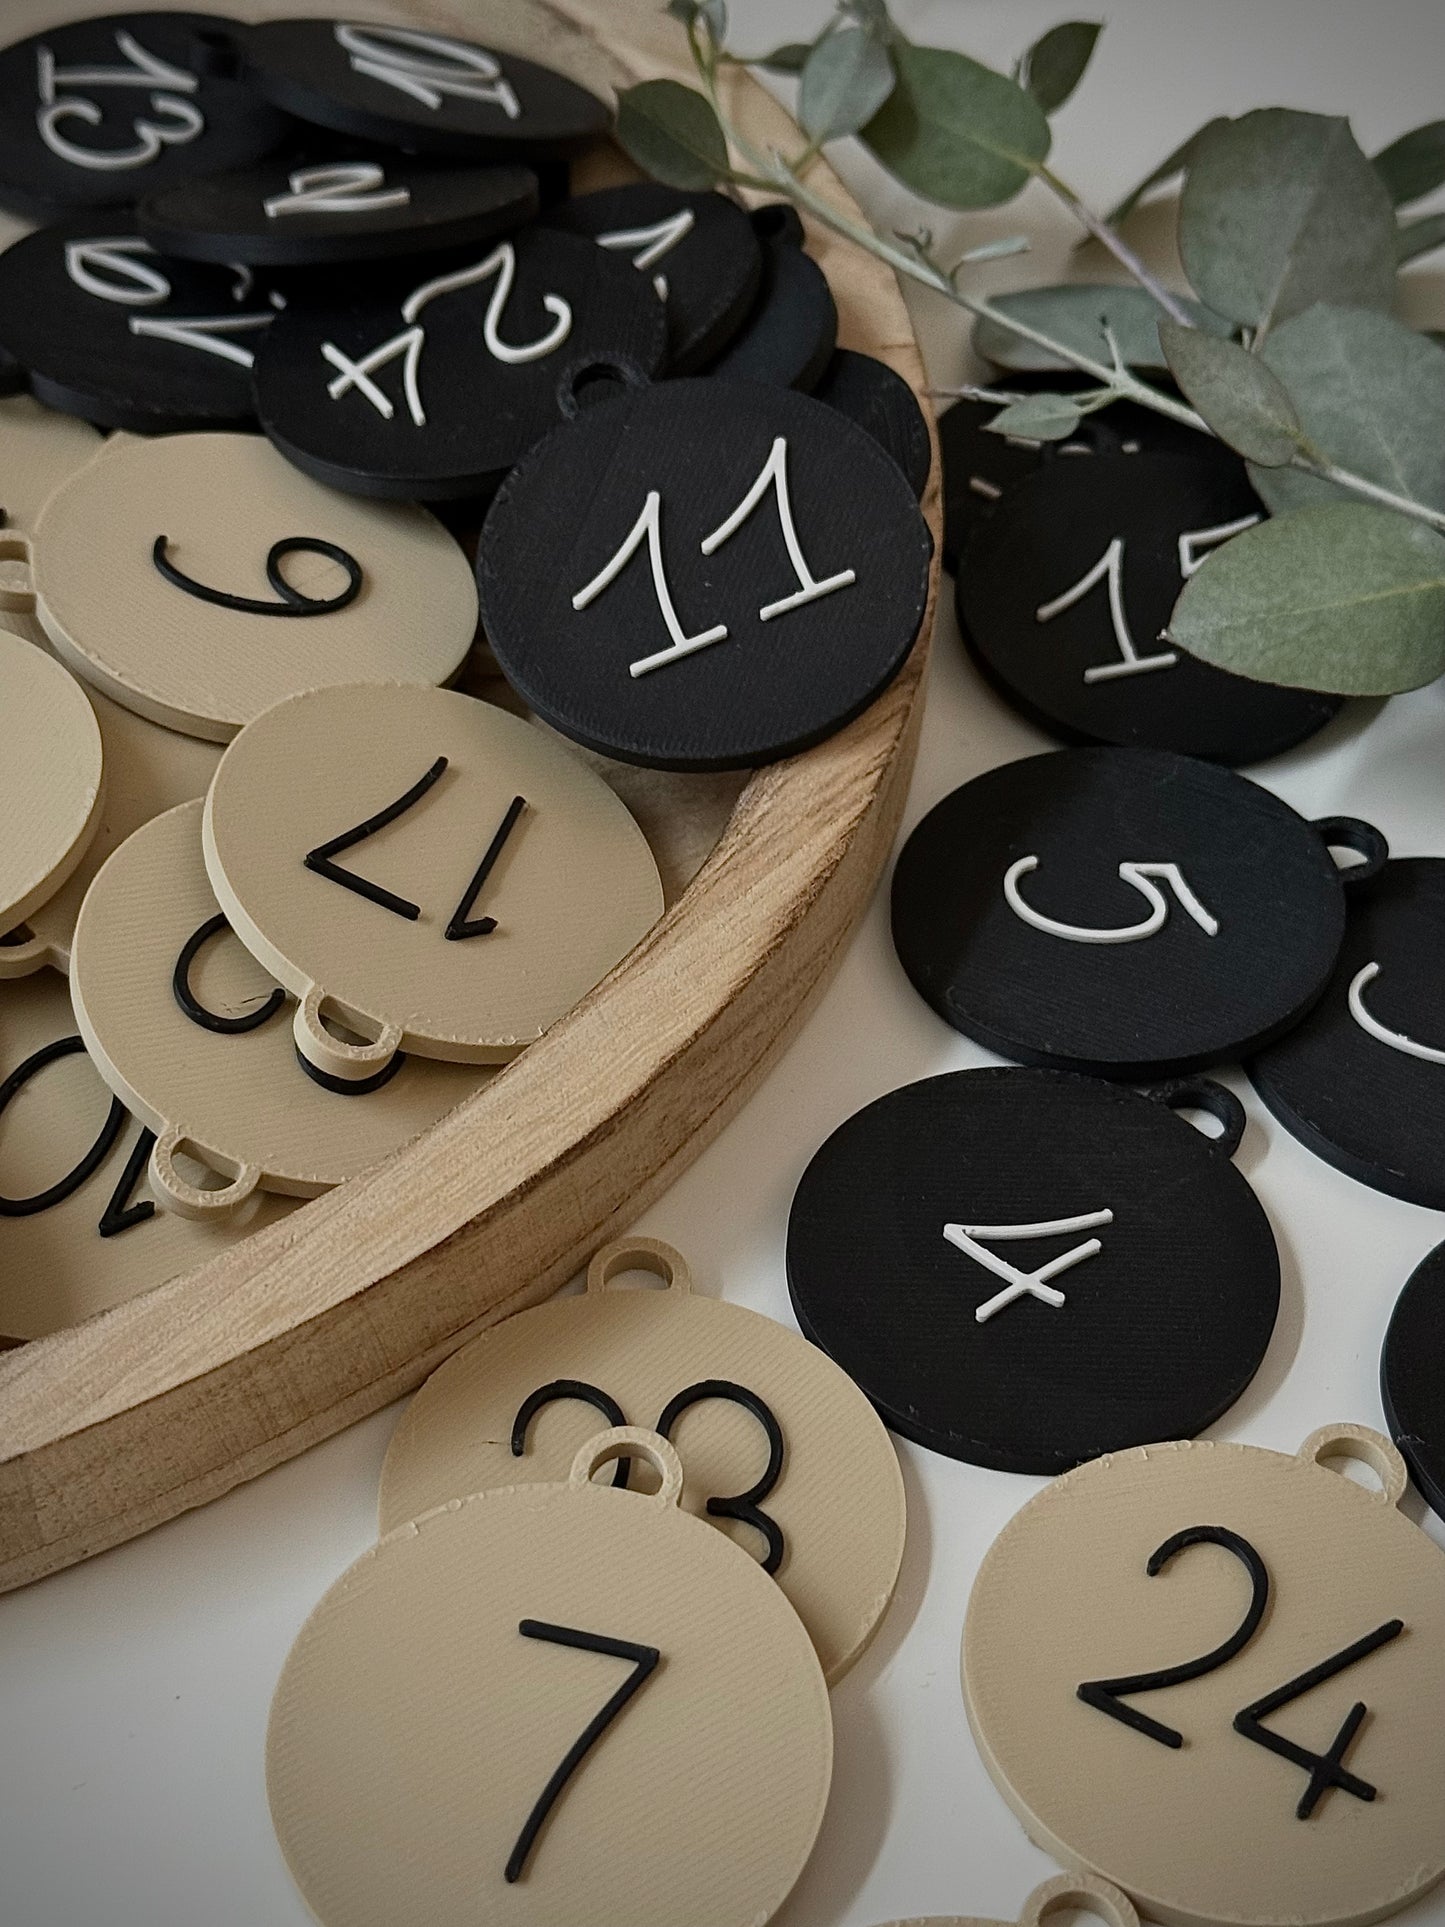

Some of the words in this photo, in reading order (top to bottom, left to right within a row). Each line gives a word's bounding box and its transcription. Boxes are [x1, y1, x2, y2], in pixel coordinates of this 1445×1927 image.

[37, 29, 203, 170] 13
[334, 22, 520, 119] 10
[263, 162, 411, 218] 2
[321, 242, 573, 426] 24
[572, 437, 856, 678] 11
[303, 755, 531, 941] 17
[1003, 854, 1219, 945] 5
[943, 1207, 1115, 1323] 4
[504, 1618, 661, 1884] 7
[1075, 1524, 1406, 1822] 24
